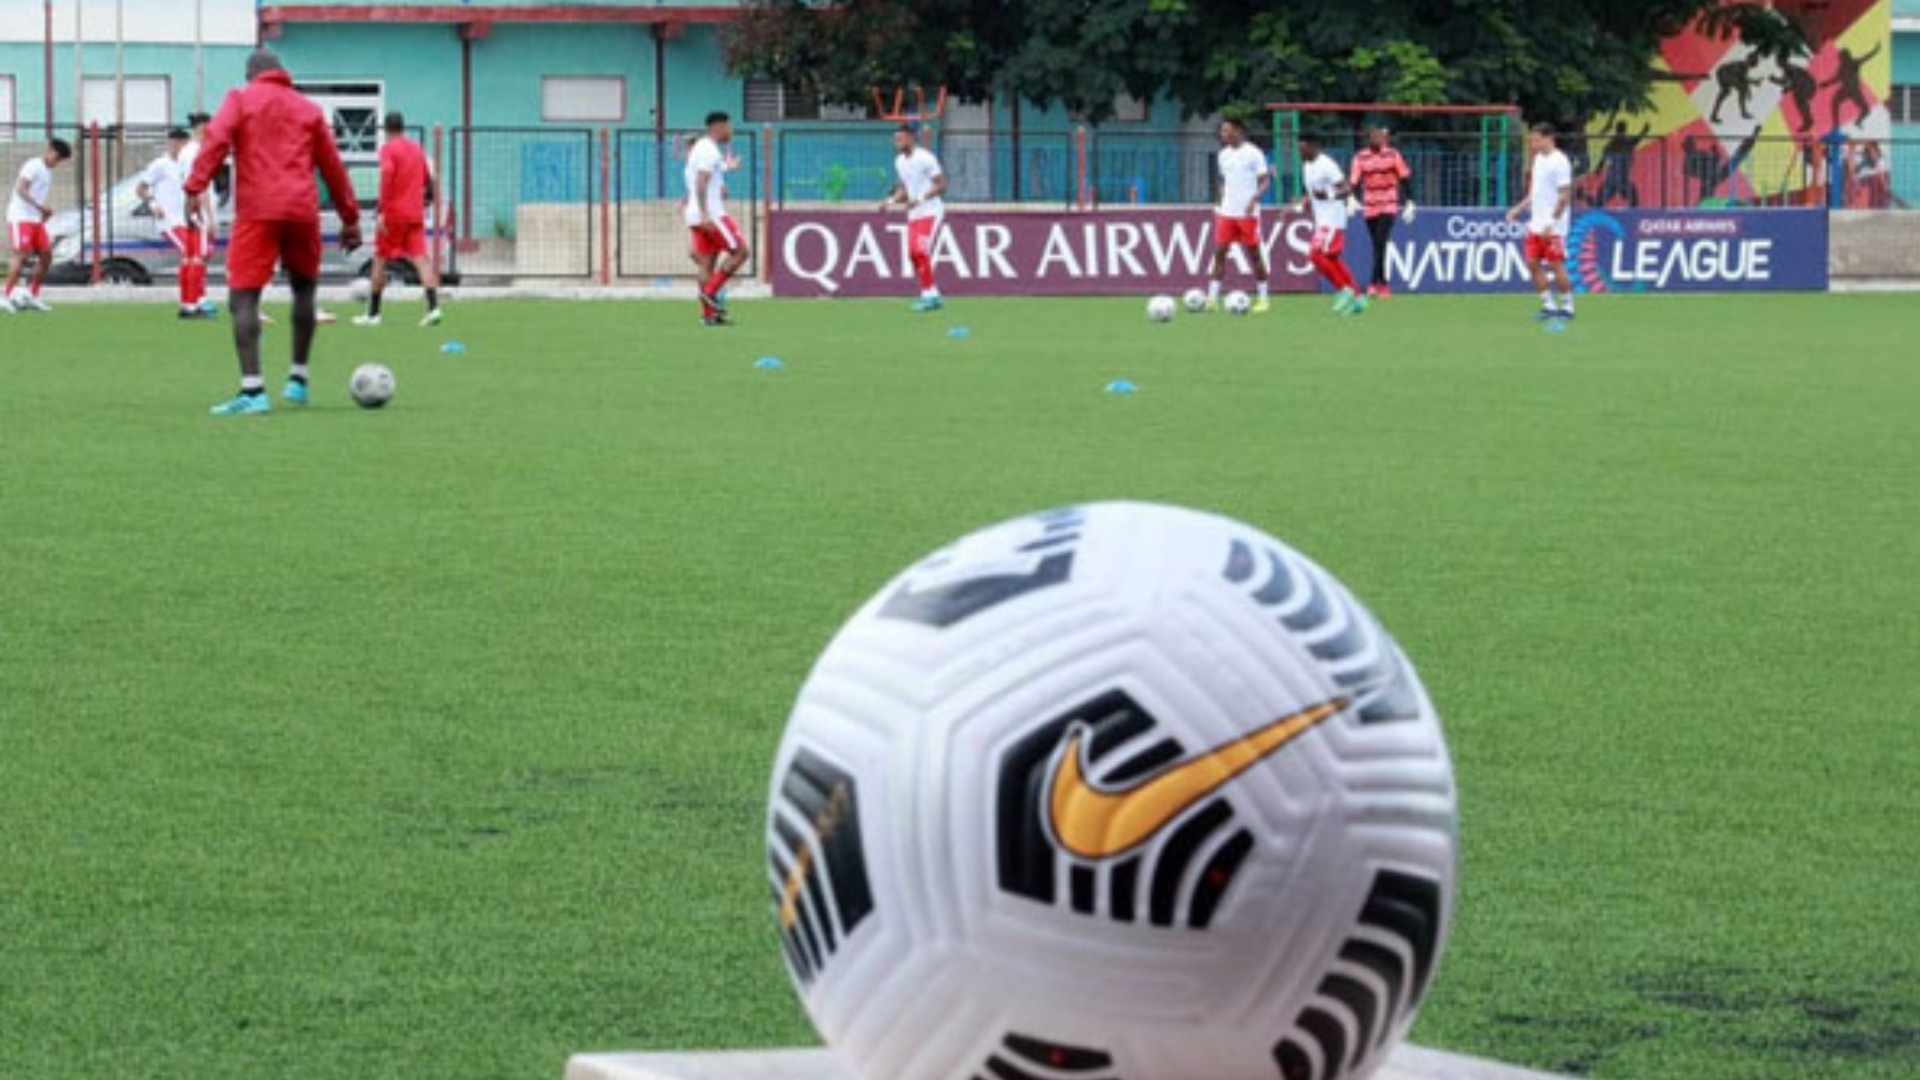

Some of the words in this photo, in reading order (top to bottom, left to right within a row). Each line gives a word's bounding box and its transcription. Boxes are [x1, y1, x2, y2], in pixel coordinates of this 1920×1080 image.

[782, 220, 1018, 292] QATAR
[1384, 241, 1556, 290] NATION
[1611, 238, 1772, 288] LEAGUE
